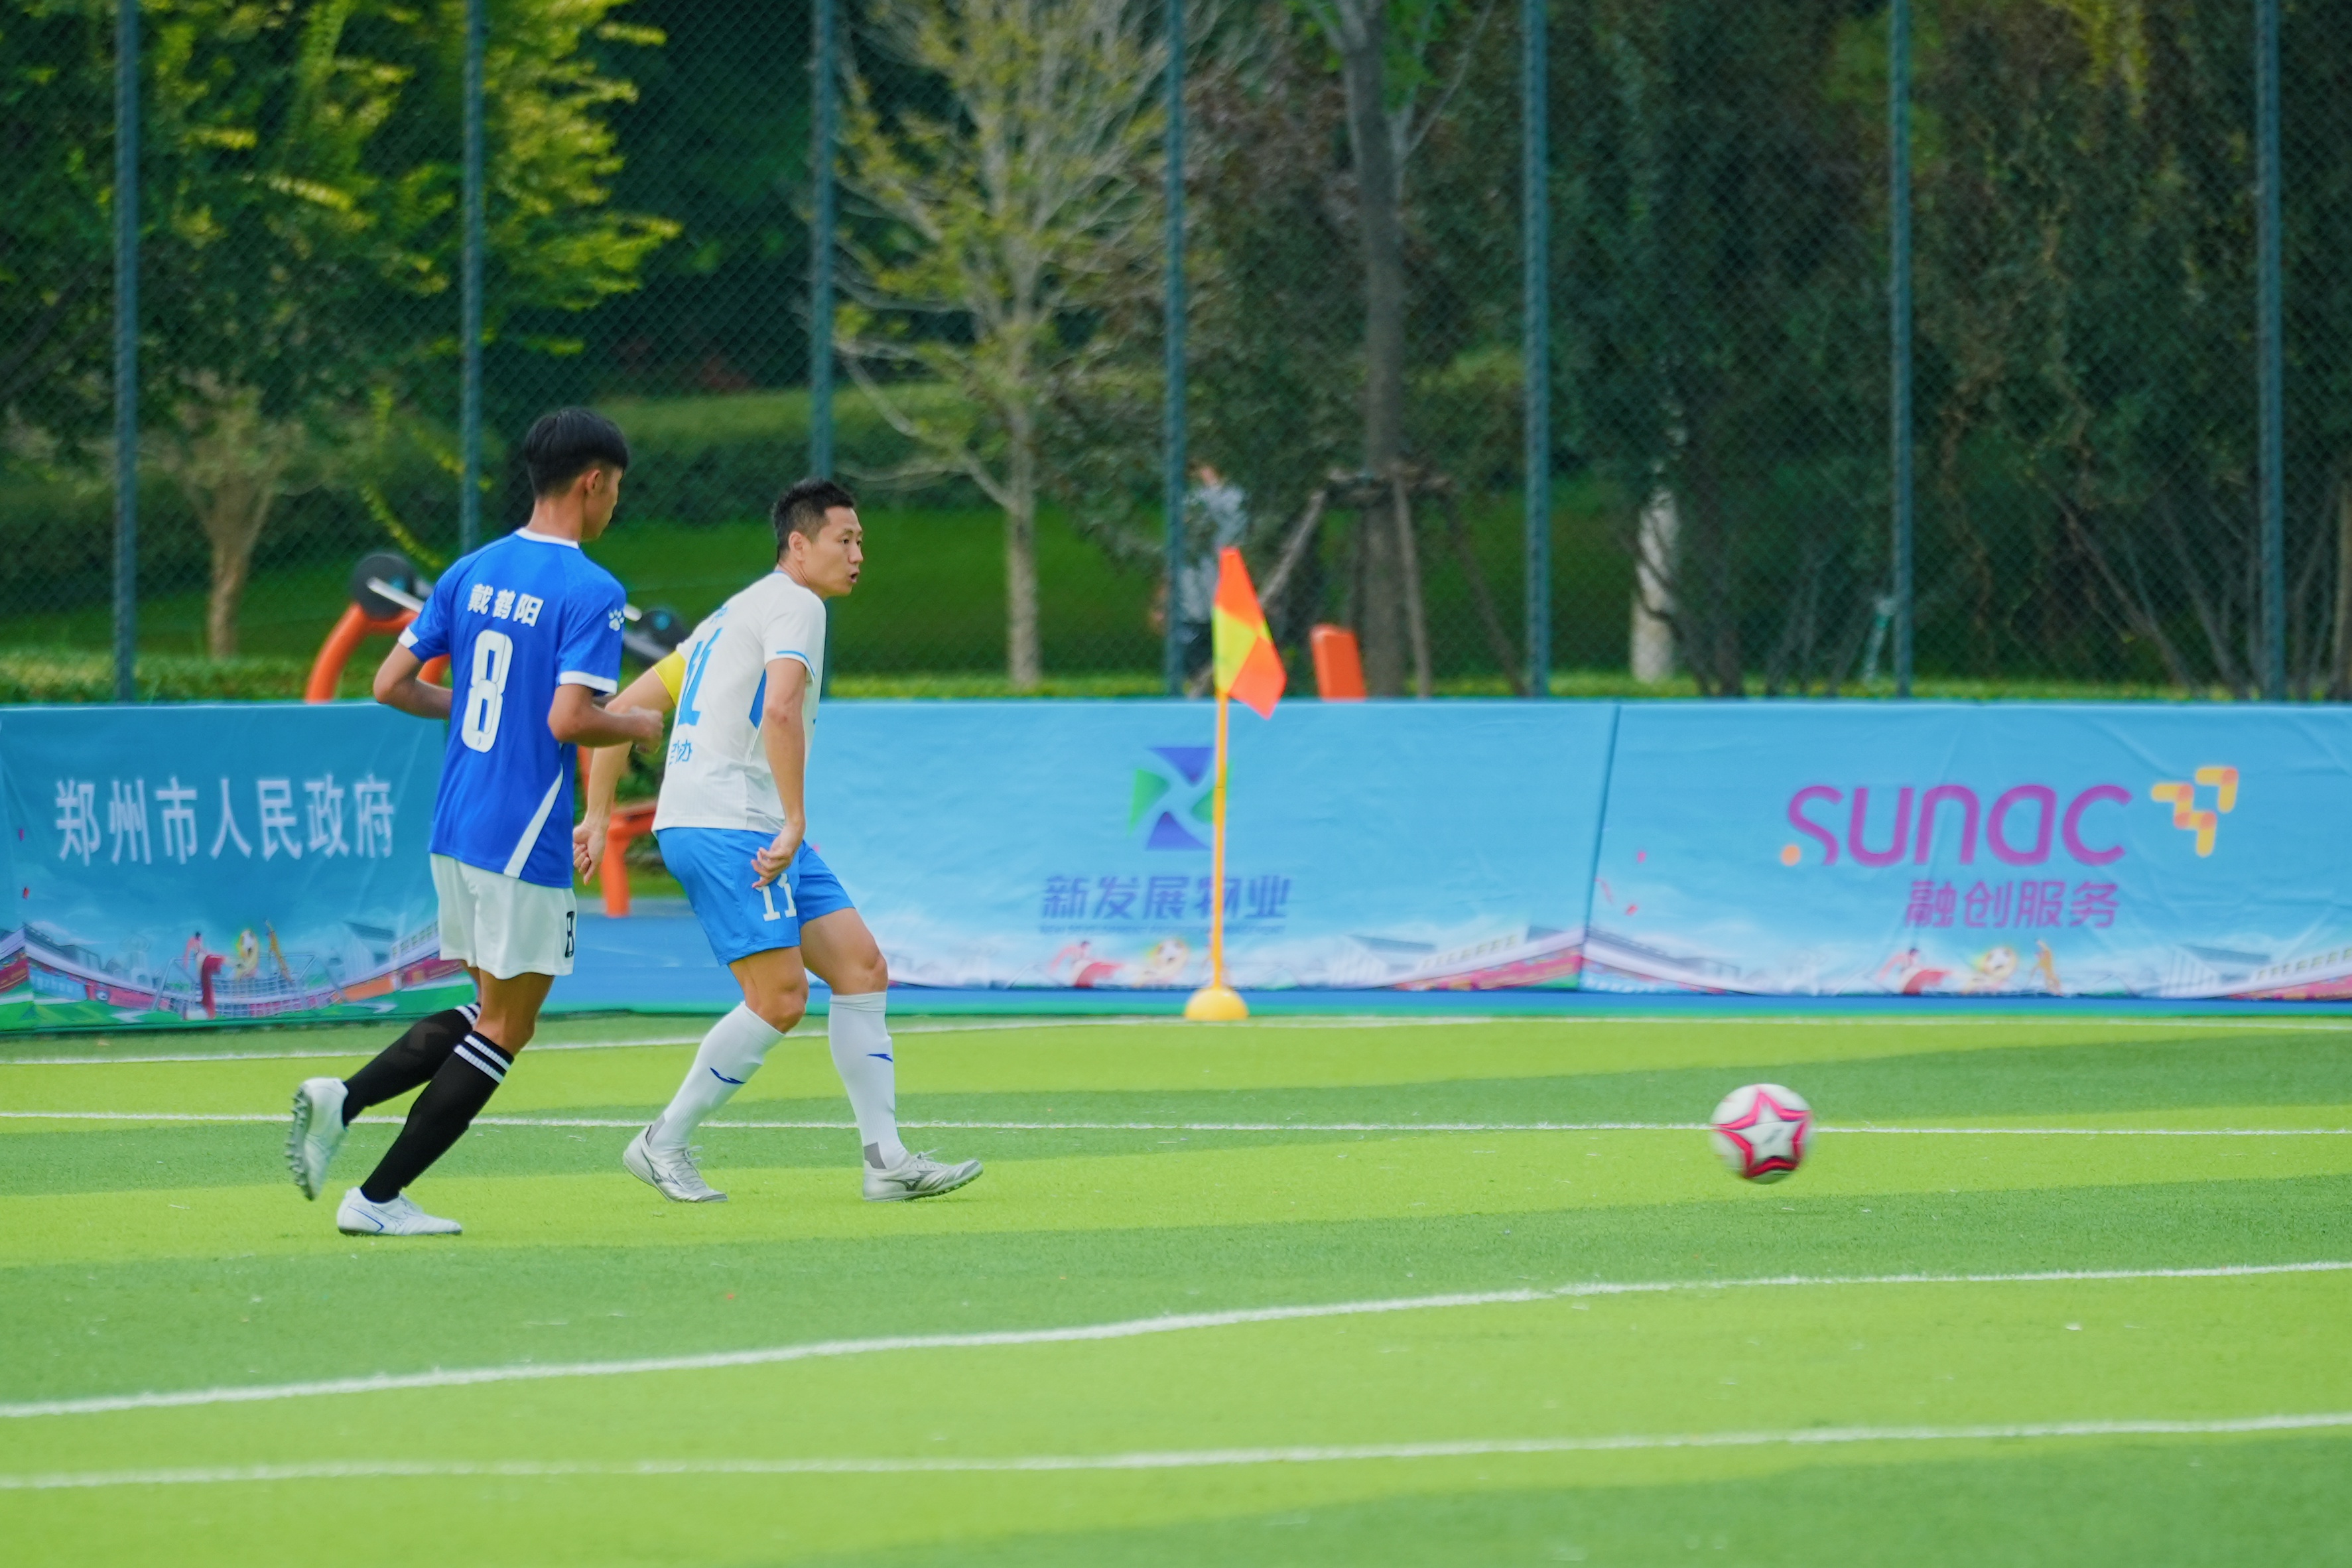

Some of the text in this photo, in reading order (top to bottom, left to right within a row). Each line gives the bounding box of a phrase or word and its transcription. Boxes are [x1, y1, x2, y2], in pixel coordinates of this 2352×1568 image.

[467, 583, 544, 627] 戴鹤阳
[461, 629, 513, 753] 8
[55, 774, 395, 866] 郑州市人民政府
[755, 873, 797, 922] 11
[1039, 875, 1291, 920] 新发展物业
[1906, 880, 2119, 928] 融创服务
